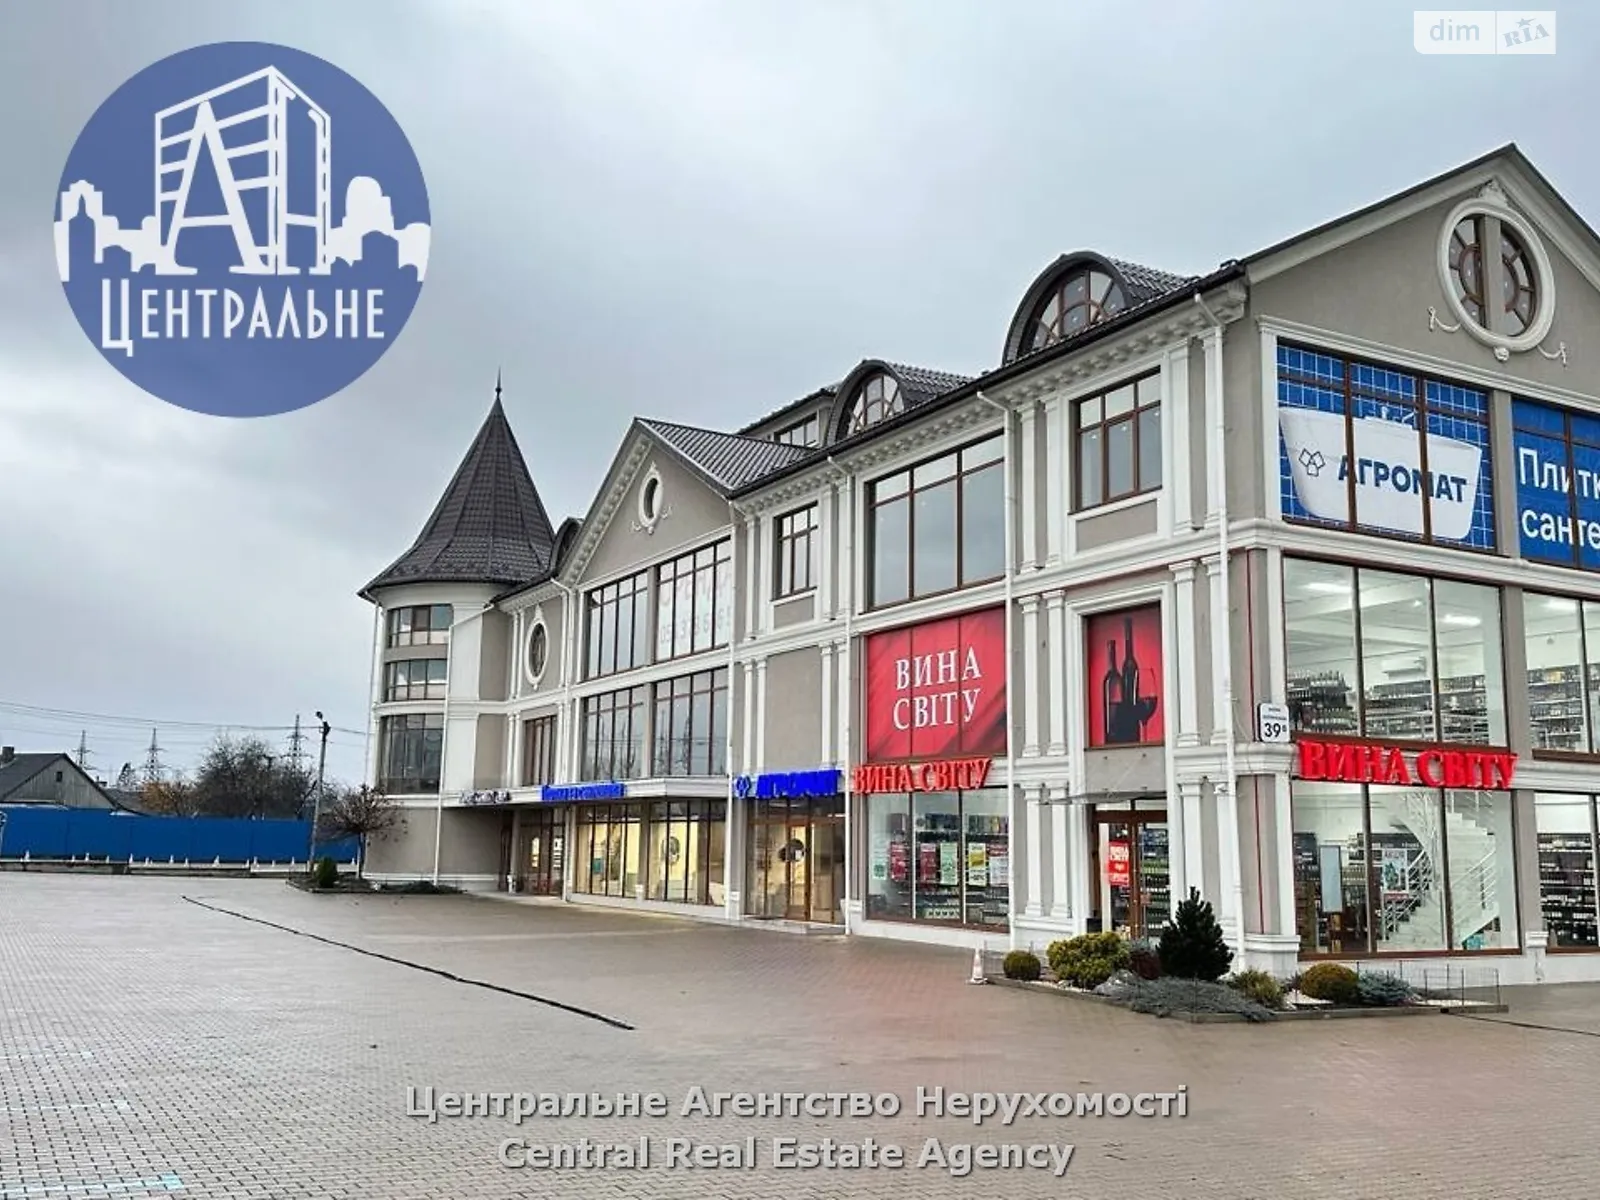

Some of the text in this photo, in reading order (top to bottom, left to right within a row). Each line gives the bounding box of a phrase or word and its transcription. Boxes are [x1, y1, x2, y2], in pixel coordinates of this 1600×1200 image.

[1338, 454, 1468, 503] АГРОМАТ
[895, 646, 983, 691] ВИНА
[892, 687, 982, 731] СВІТУ
[853, 758, 992, 794] ВИНА СВІТУ
[1297, 739, 1519, 789] ВИНА СВІТУ
